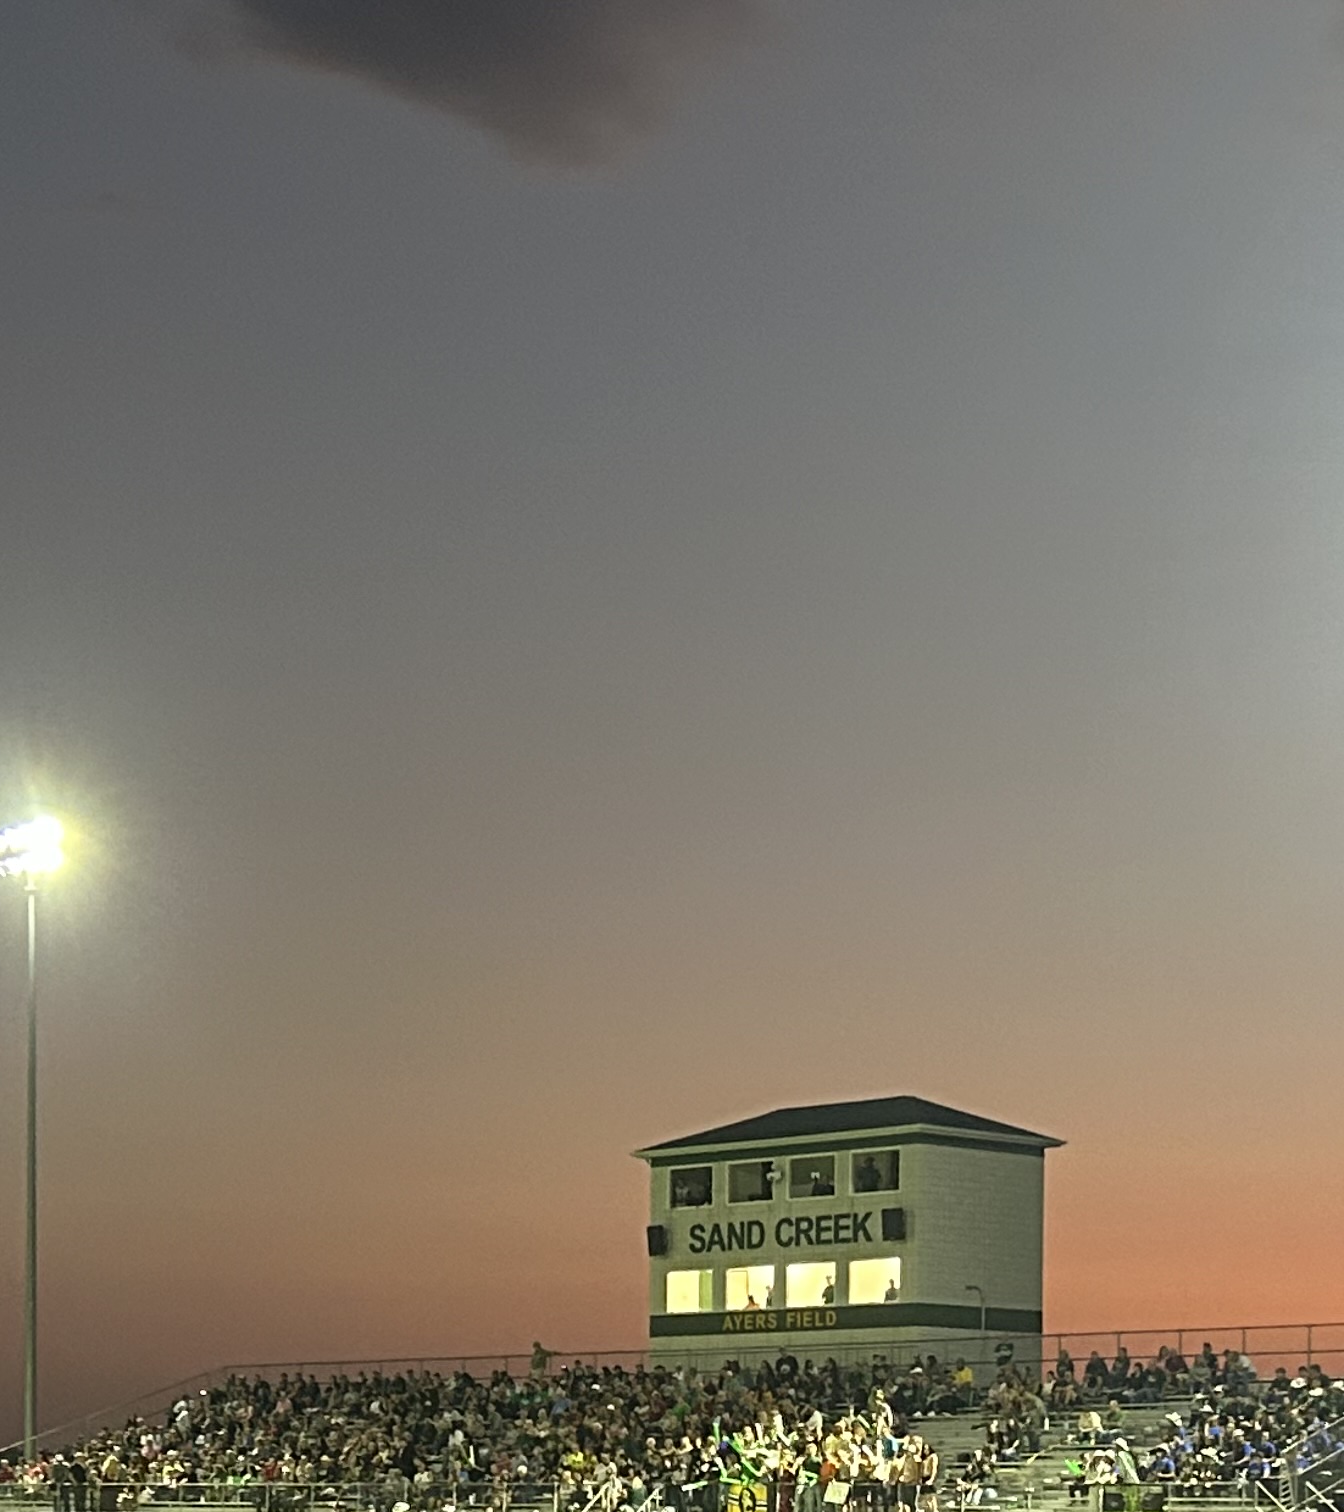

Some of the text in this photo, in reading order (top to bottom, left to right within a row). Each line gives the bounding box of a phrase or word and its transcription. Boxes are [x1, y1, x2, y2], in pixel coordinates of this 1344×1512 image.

[689, 1211, 874, 1254] SAND CREEK
[722, 1310, 838, 1332] AYERS FIELD
